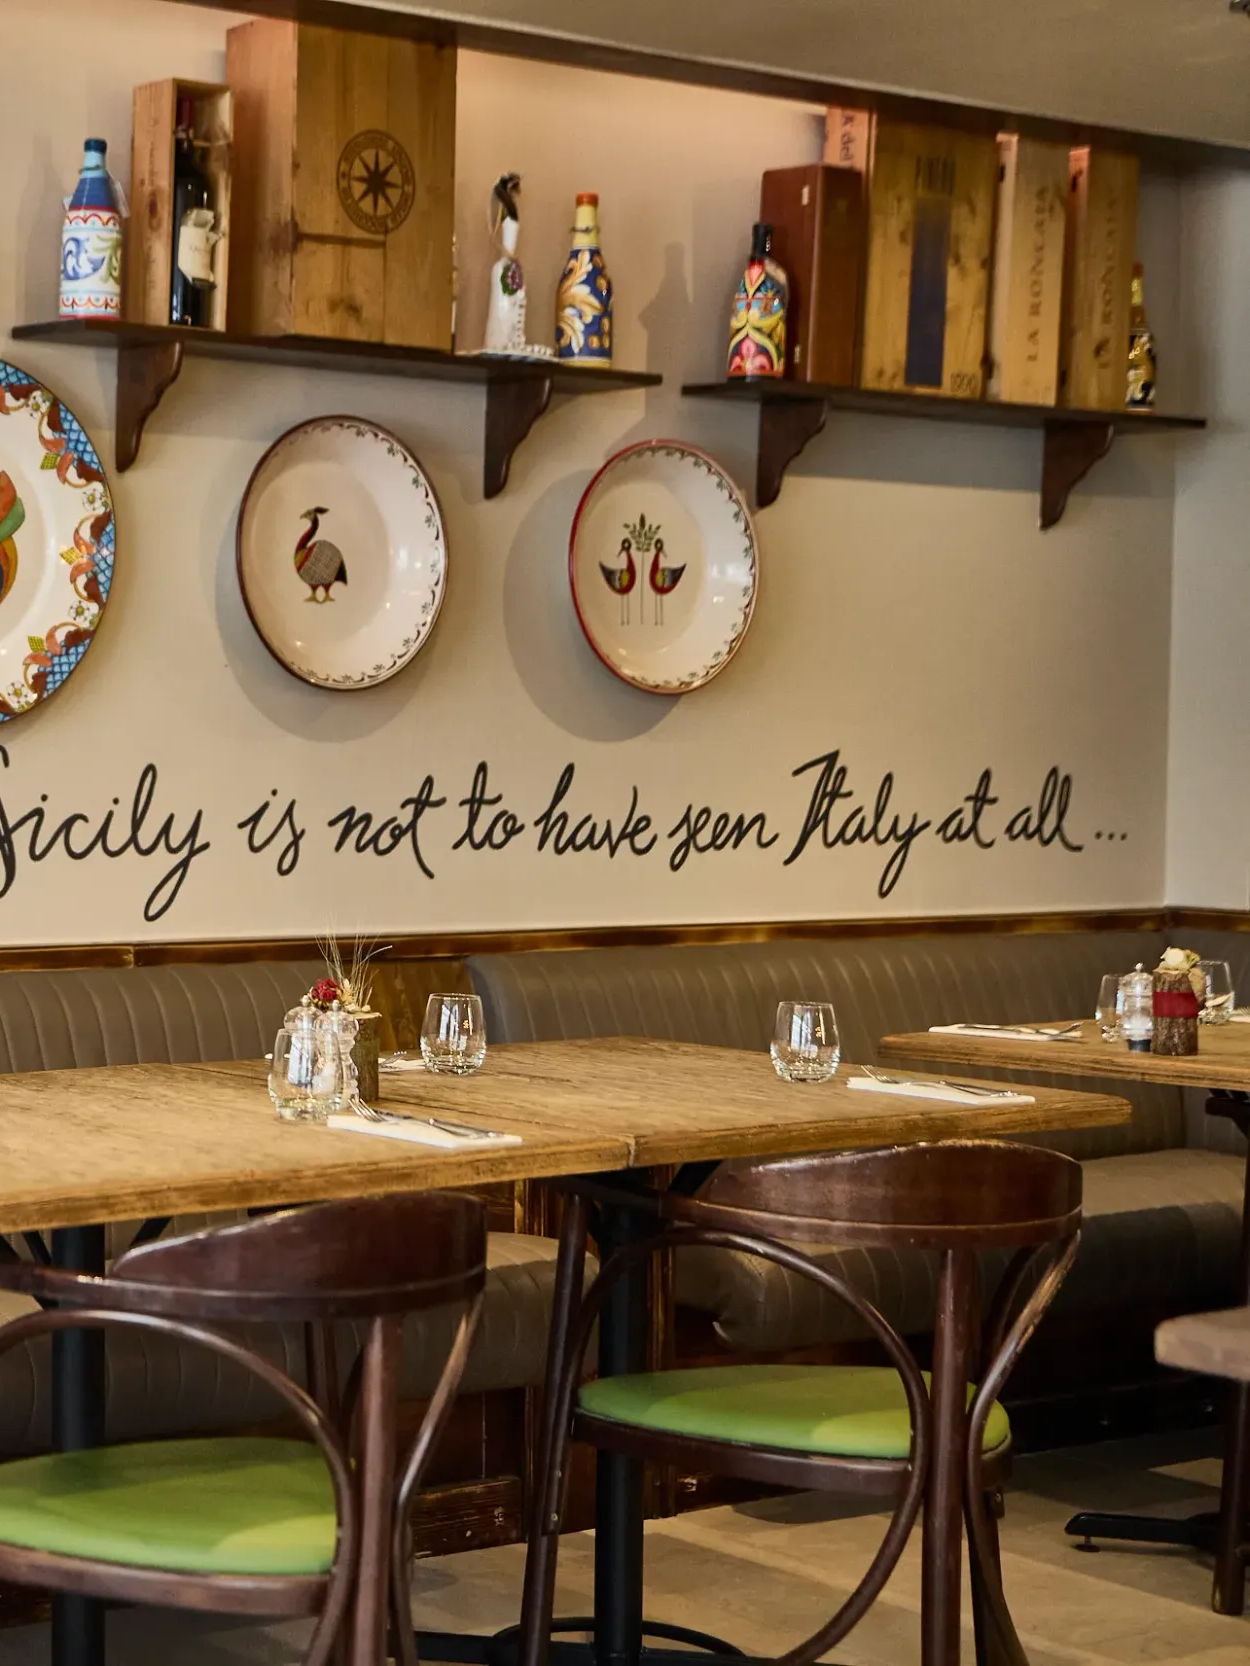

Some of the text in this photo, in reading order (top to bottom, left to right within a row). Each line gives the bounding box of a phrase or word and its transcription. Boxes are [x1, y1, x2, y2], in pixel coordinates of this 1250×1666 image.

[237, 788, 306, 877] is
[327, 774, 447, 880] not
[451, 761, 525, 851] to
[533, 762, 658, 859] have
[667, 804, 780, 872] seen
[782, 749, 932, 899] Italy
[935, 767, 999, 850] at
